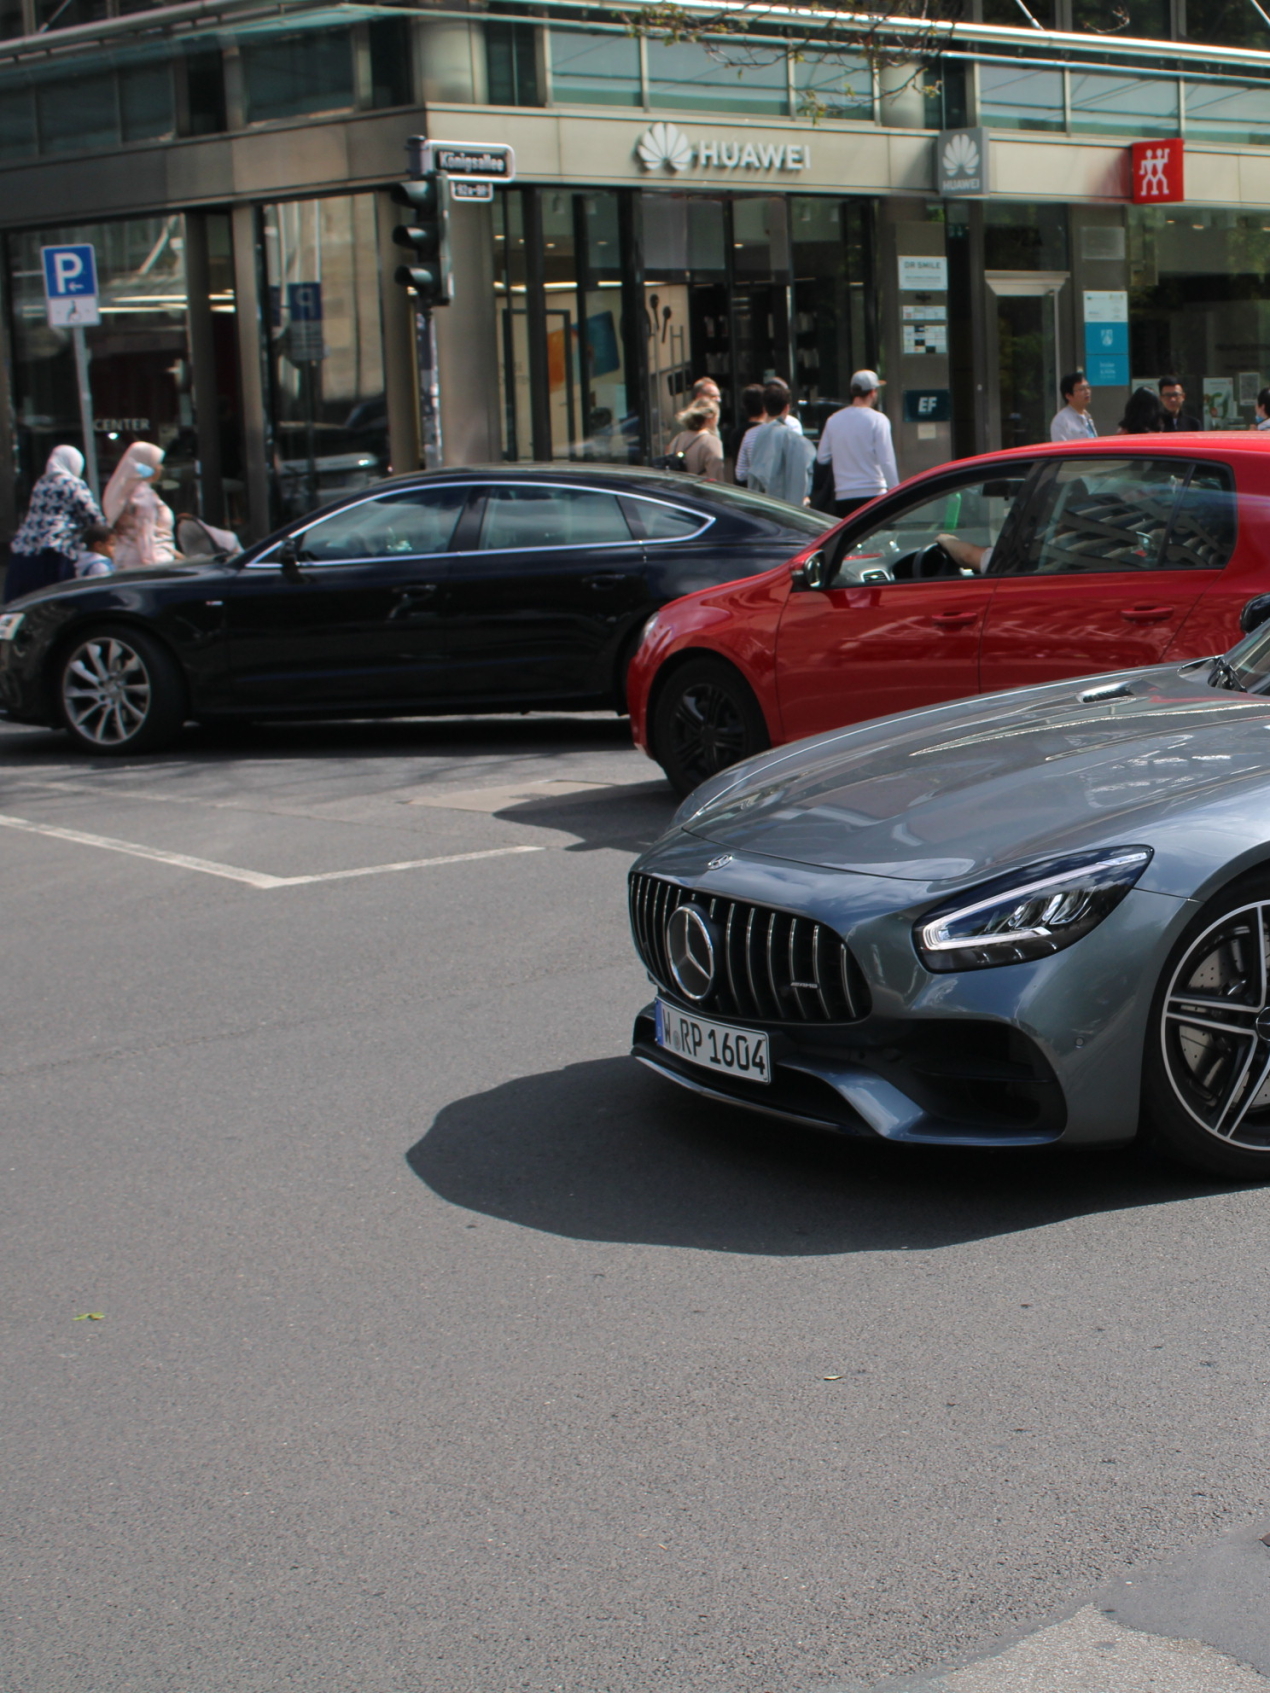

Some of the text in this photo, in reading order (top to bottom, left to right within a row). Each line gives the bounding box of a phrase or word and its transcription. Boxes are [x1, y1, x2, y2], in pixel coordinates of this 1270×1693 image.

[438, 150, 505, 173] Königsallee
[700, 140, 812, 170] HUAWEI
[942, 178, 980, 191] HUAWEI
[53, 251, 84, 294] P
[918, 396, 938, 413] EF
[93, 417, 150, 432] CENTER
[680, 1017, 703, 1057] RP
[707, 1028, 766, 1075] 1604
